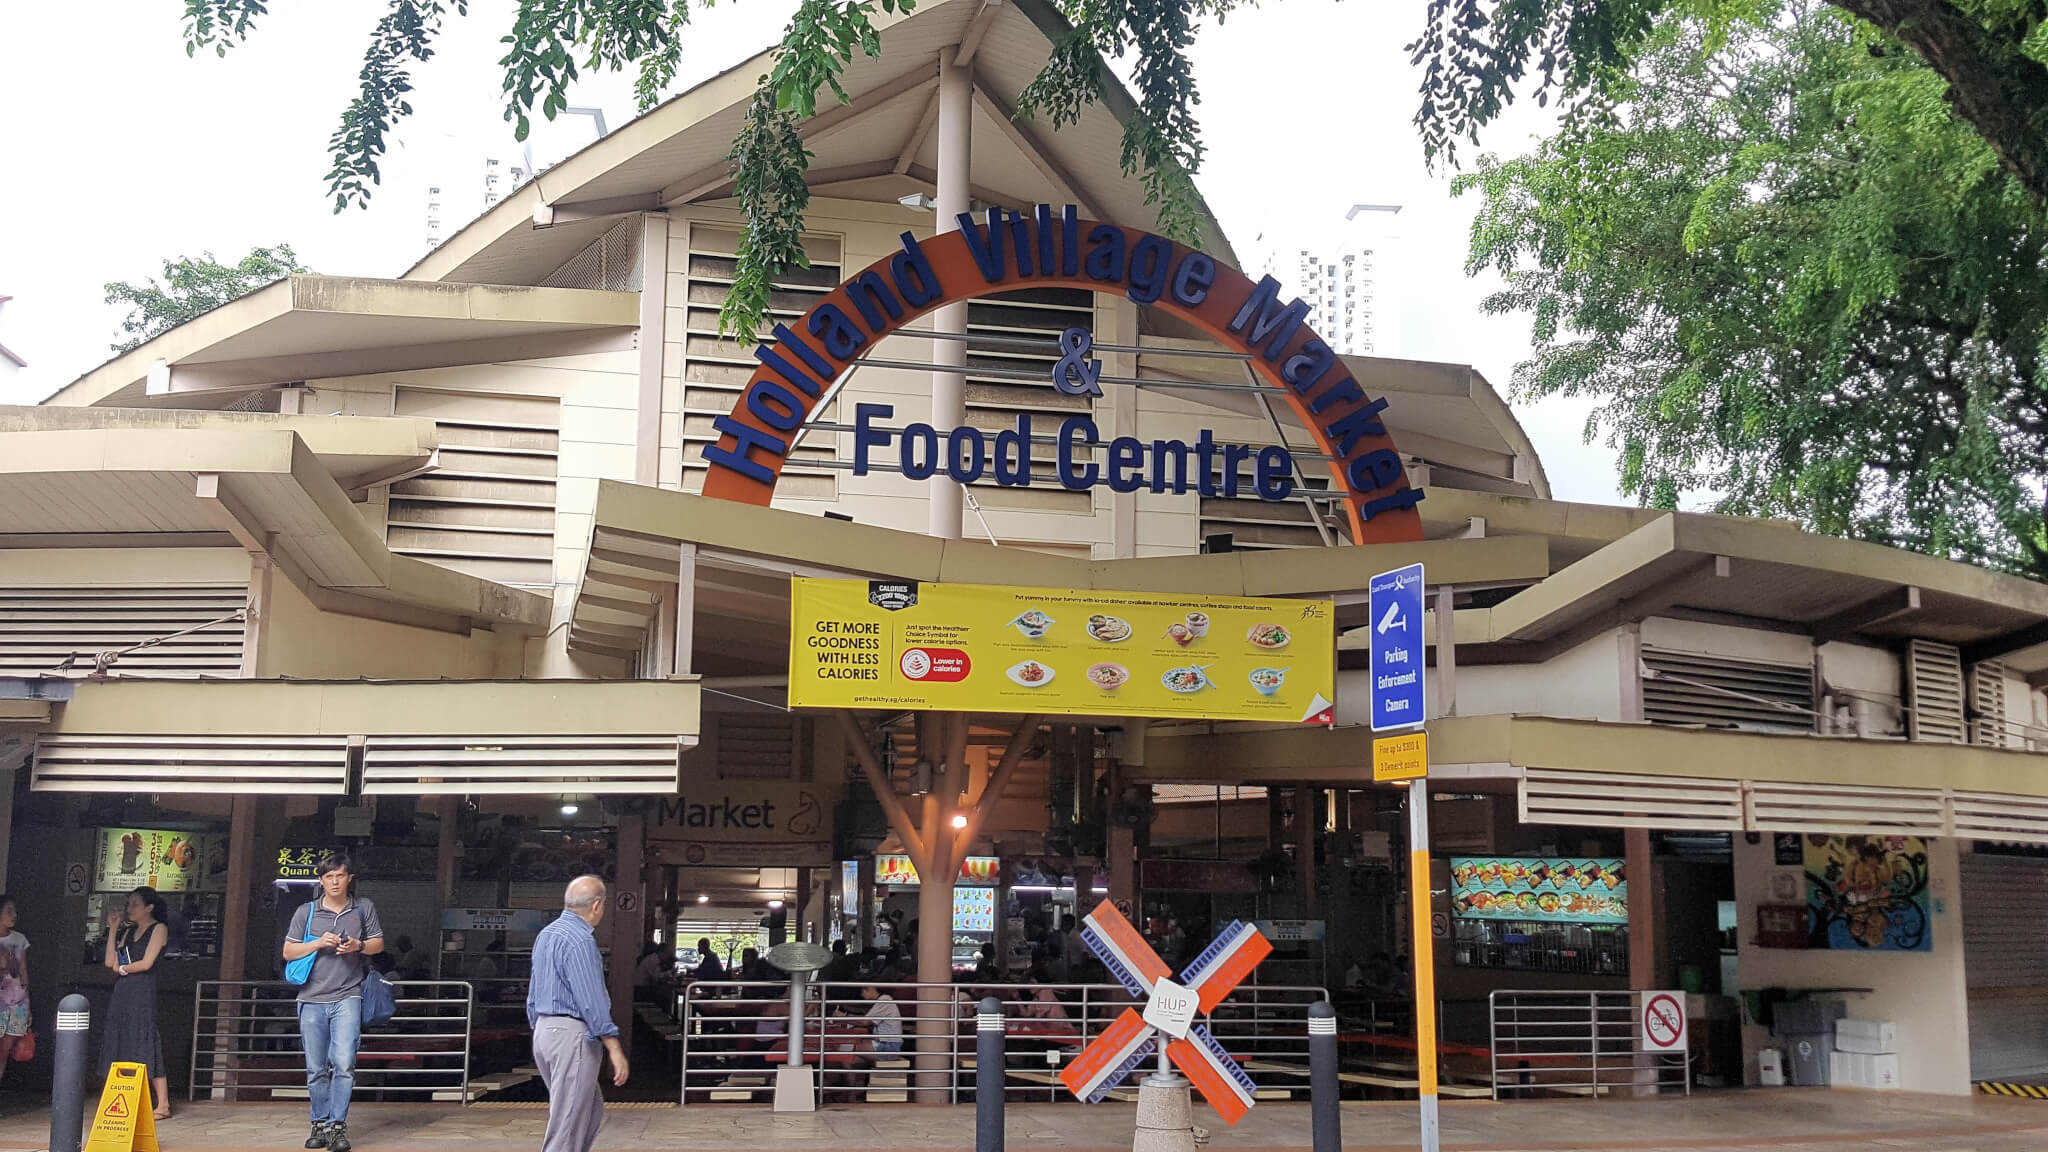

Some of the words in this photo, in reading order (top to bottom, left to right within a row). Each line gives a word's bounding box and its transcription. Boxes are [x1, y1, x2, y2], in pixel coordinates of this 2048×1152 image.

[702, 231, 944, 484] Holland
[955, 204, 1216, 309] Village
[1225, 273, 1426, 521] Market
[1052, 328, 1103, 398] &
[854, 403, 1031, 487] Food
[1055, 416, 1293, 502] Centre
[816, 621, 840, 632] GET
[842, 622, 880, 634] MORE
[808, 636, 880, 650] GOODNESS
[817, 652, 849, 664] WITH
[852, 653, 879, 664] LESS
[1385, 647, 1408, 664] Parking
[818, 668, 878, 680] CALORIES
[934, 664, 961, 672] calories
[1378, 669, 1417, 689] Enforcement
[1386, 699, 1409, 712] Camera
[658, 796, 776, 829] Market
[280, 866, 310, 877] Quan
[1157, 996, 1188, 1012] HUP
